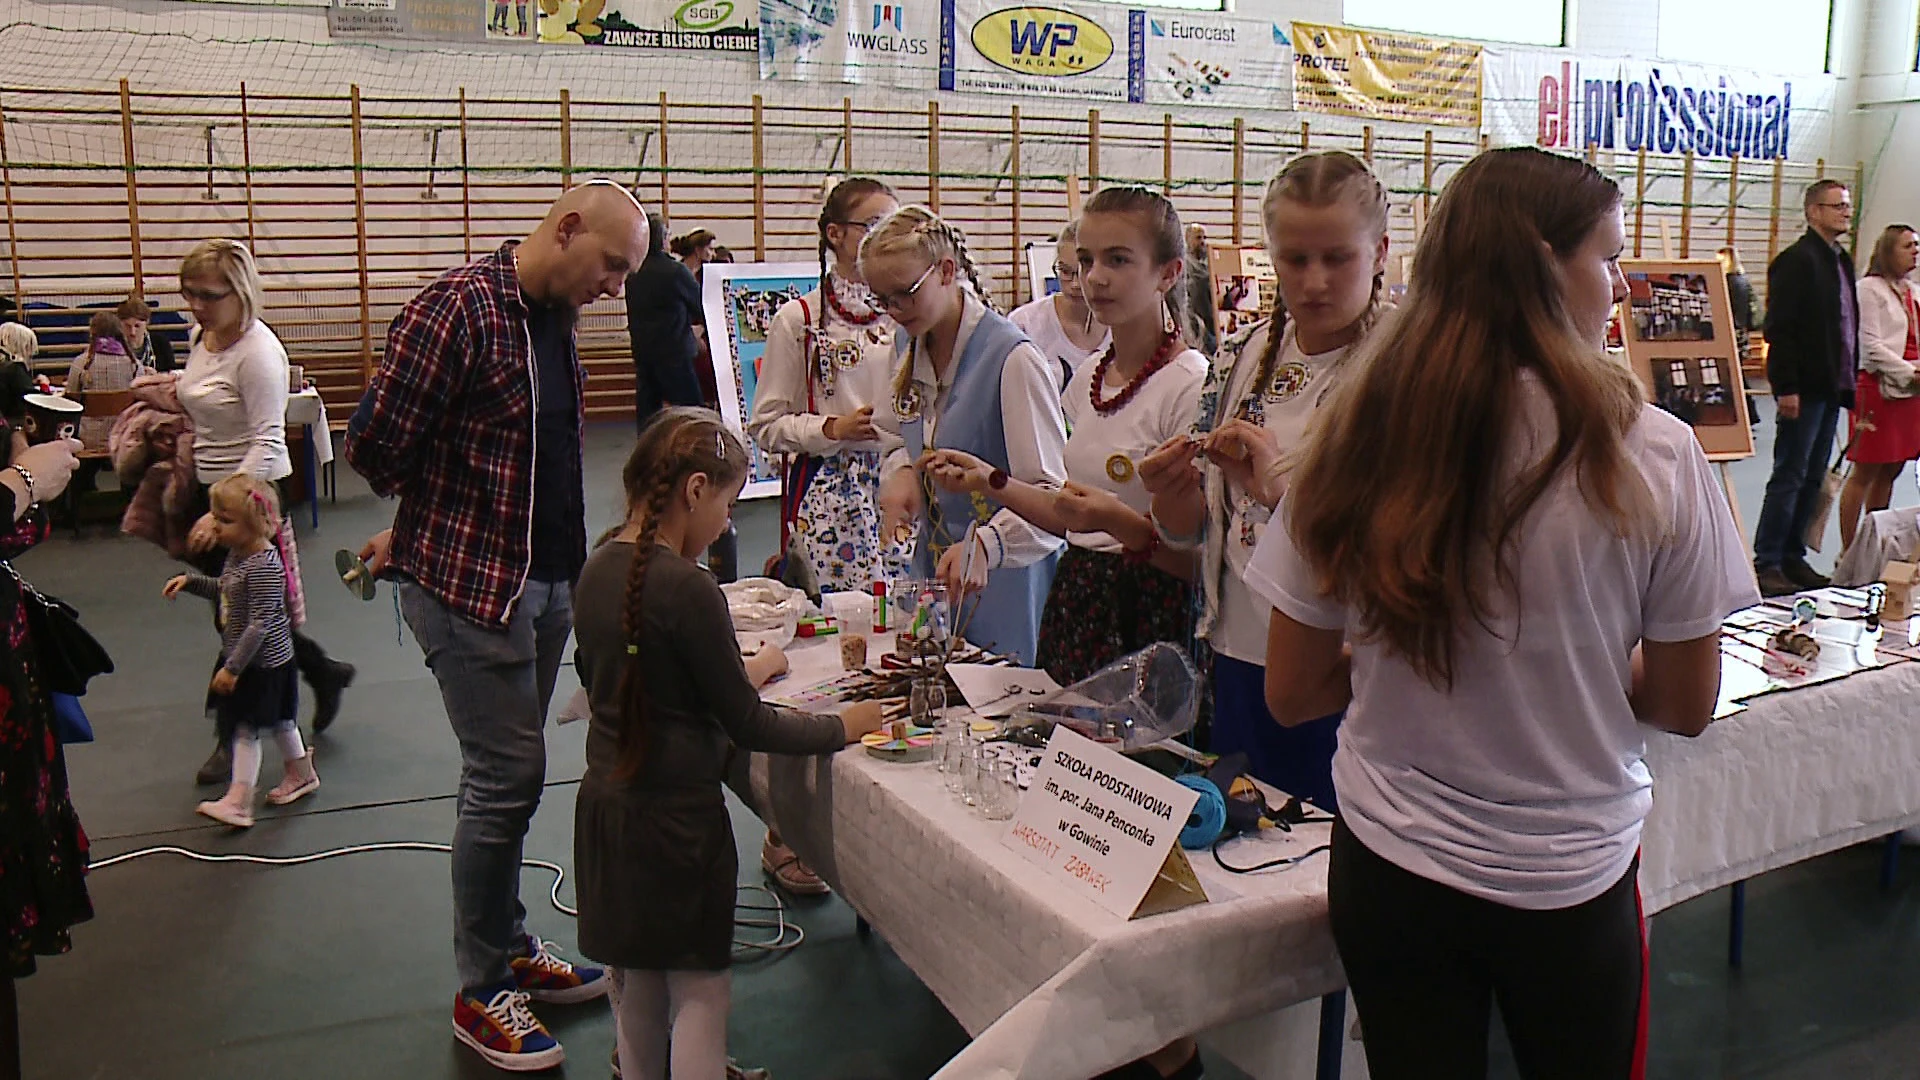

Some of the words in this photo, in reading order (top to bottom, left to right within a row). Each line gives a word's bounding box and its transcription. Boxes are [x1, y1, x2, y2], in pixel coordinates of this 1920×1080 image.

[690, 7, 719, 20] SGB
[604, 30, 660, 47] ZAWSZE
[662, 33, 711, 49] BLISKO
[713, 35, 758, 50] CIEBIE
[847, 31, 928, 55] WWGLASS
[1011, 19, 1078, 57] WP
[1171, 21, 1236, 42] Eurocast
[1012, 57, 1056, 67] WAGA
[1293, 53, 1350, 72] PROTEL
[1537, 61, 1570, 147] el
[1583, 68, 1792, 160] professional
[1054, 751, 1093, 780] SZKOŁA
[1092, 771, 1173, 821] PODSTAWOWA
[1059, 788, 1079, 807] por.
[1080, 797, 1105, 820] Jana
[1104, 810, 1155, 847] Penconka
[1058, 818, 1070, 831] w
[1069, 823, 1110, 856] Gowinie
[1012, 821, 1060, 859] WARSZTAT
[1063, 855, 1112, 893] ZABAWEK
